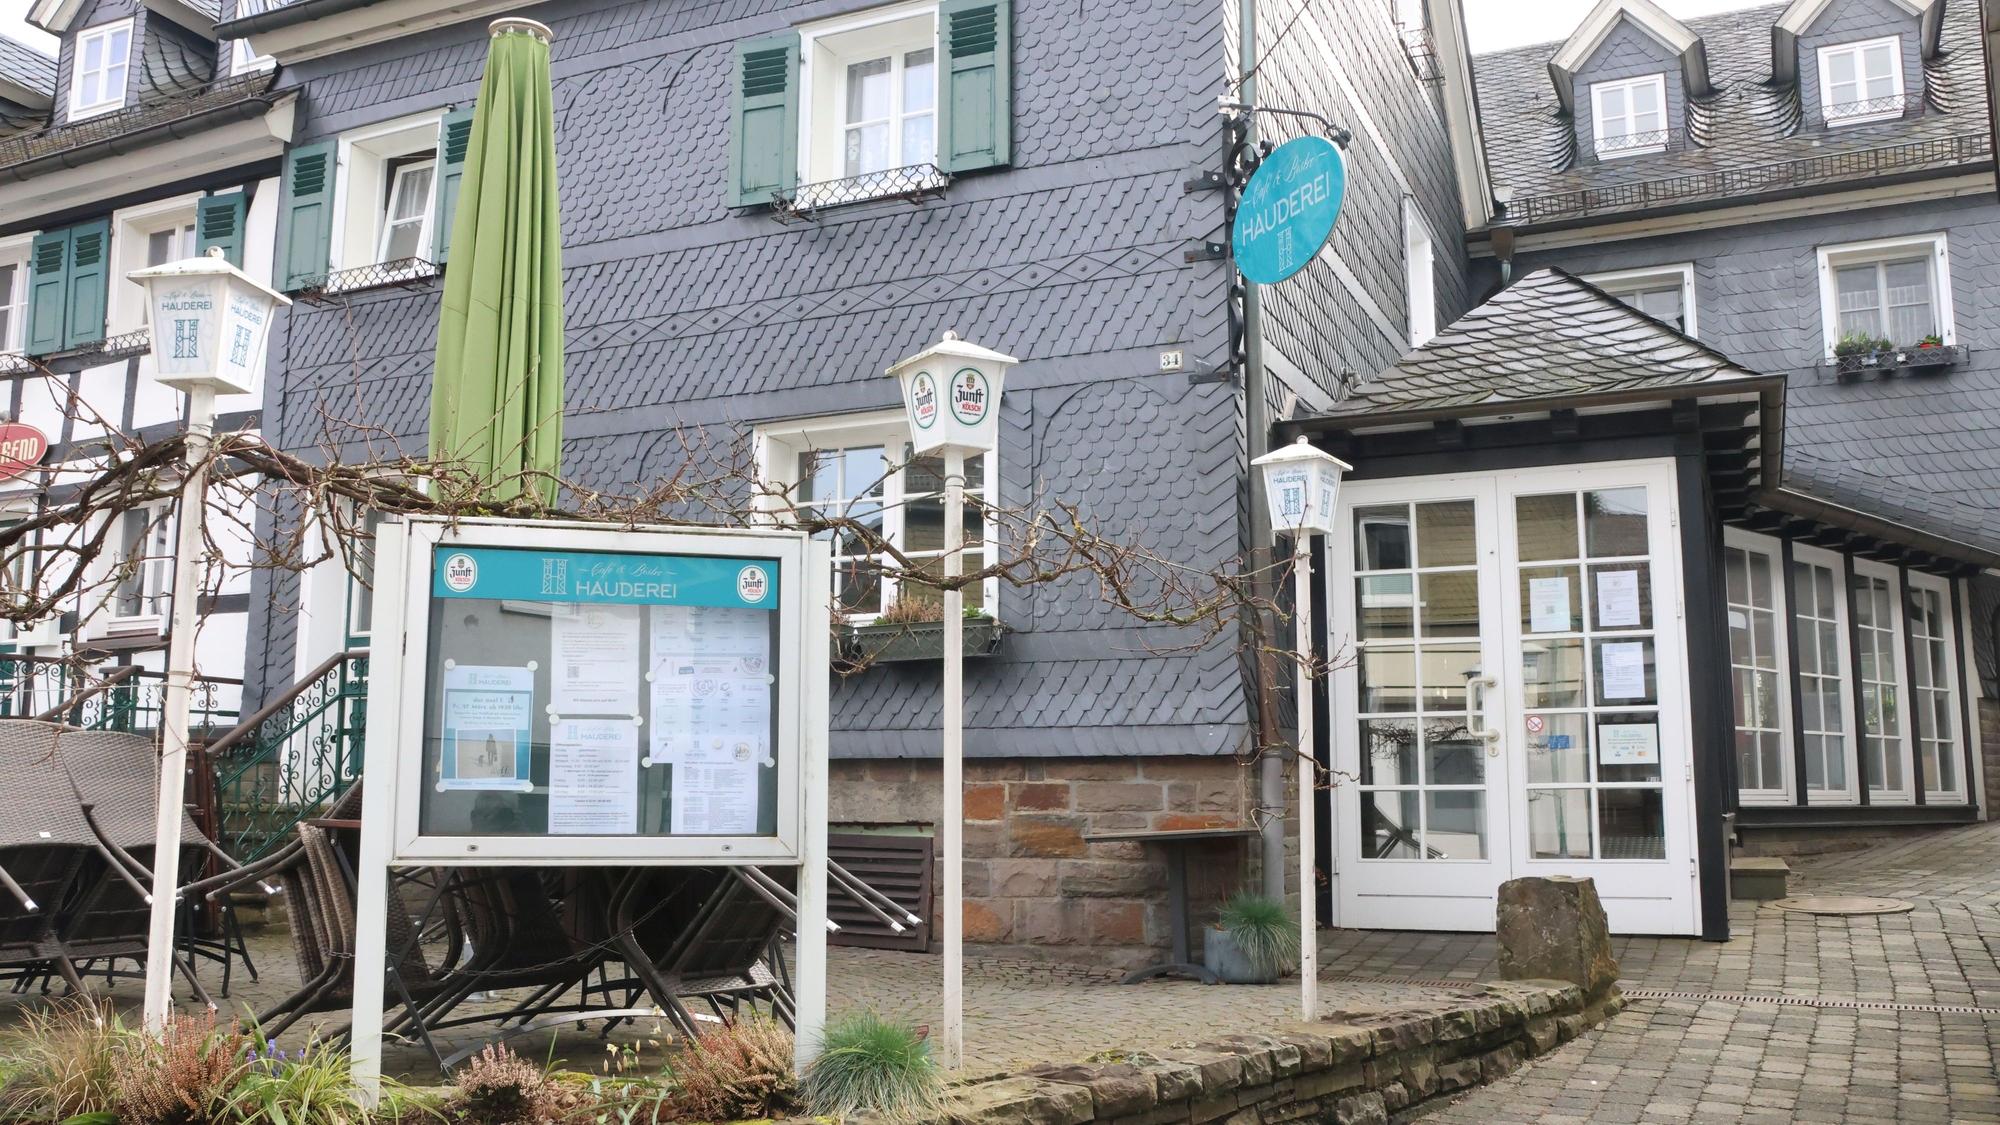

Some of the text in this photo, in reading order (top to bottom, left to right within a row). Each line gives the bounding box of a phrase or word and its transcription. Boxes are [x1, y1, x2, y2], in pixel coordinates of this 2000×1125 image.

[1242, 171, 1330, 247] HAUDEREI
[161, 301, 213, 311] HAUDEREI
[1162, 353, 1179, 367] 34
[0, 437, 38, 464] REND
[1273, 475, 1308, 484] HAUDEREI
[576, 581, 677, 598] HAUDEREI
